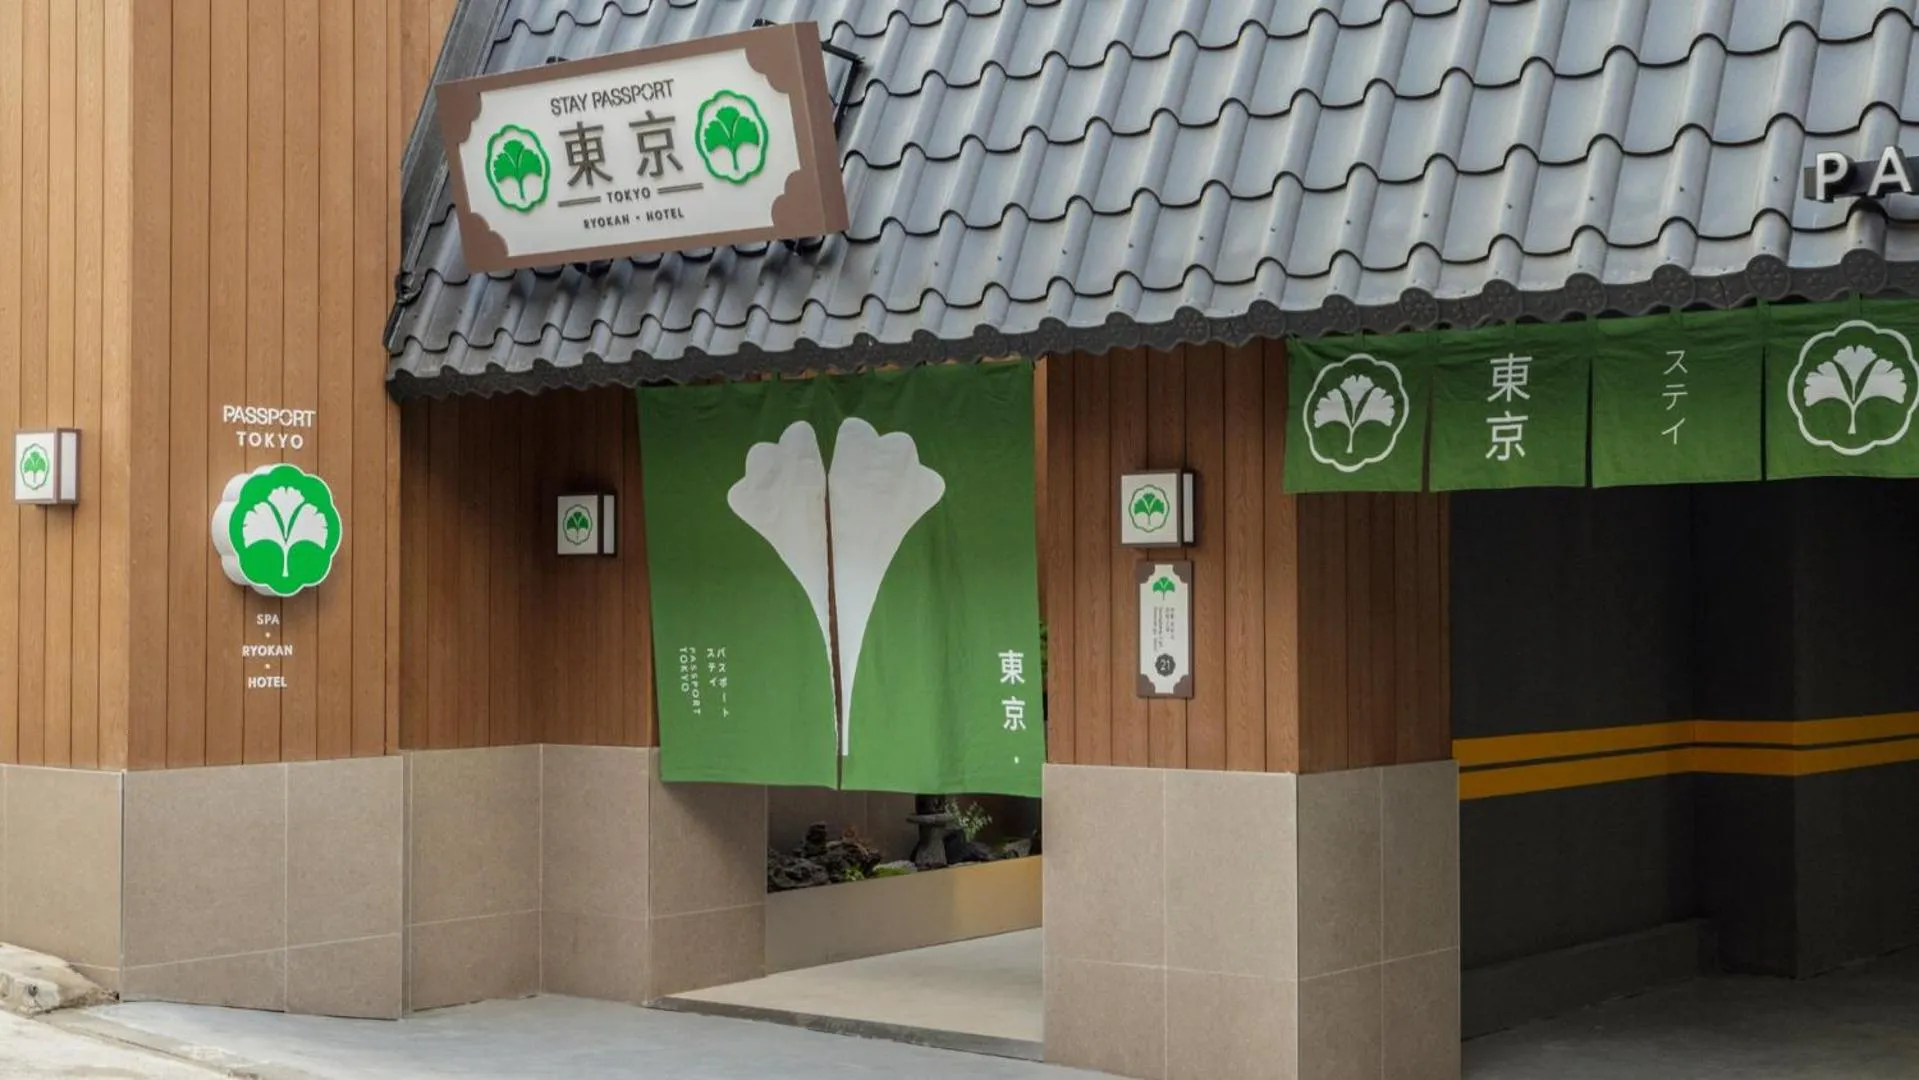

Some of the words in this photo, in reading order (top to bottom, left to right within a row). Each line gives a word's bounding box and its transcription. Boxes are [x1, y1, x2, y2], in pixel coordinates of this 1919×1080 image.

[550, 93, 588, 116] STAY
[591, 79, 675, 109] PASSPORT
[558, 110, 684, 188] 東京
[1816, 145, 1913, 202] PA
[606, 186, 652, 204] TOKYO
[583, 213, 631, 230] RYOKAN
[645, 206, 685, 221] HOTEL
[223, 405, 316, 428] PASSPORT
[1485, 353, 1533, 461] 東京
[1661, 350, 1689, 446] ステイ
[236, 430, 304, 450] TOKYO
[256, 613, 280, 626] SPA
[241, 644, 293, 657] RYOKAN
[679, 646, 690, 692] TOKYO
[247, 675, 288, 689] HOTEL
[689, 647, 701, 715] PASSPORT
[998, 649, 1027, 731] 東京
